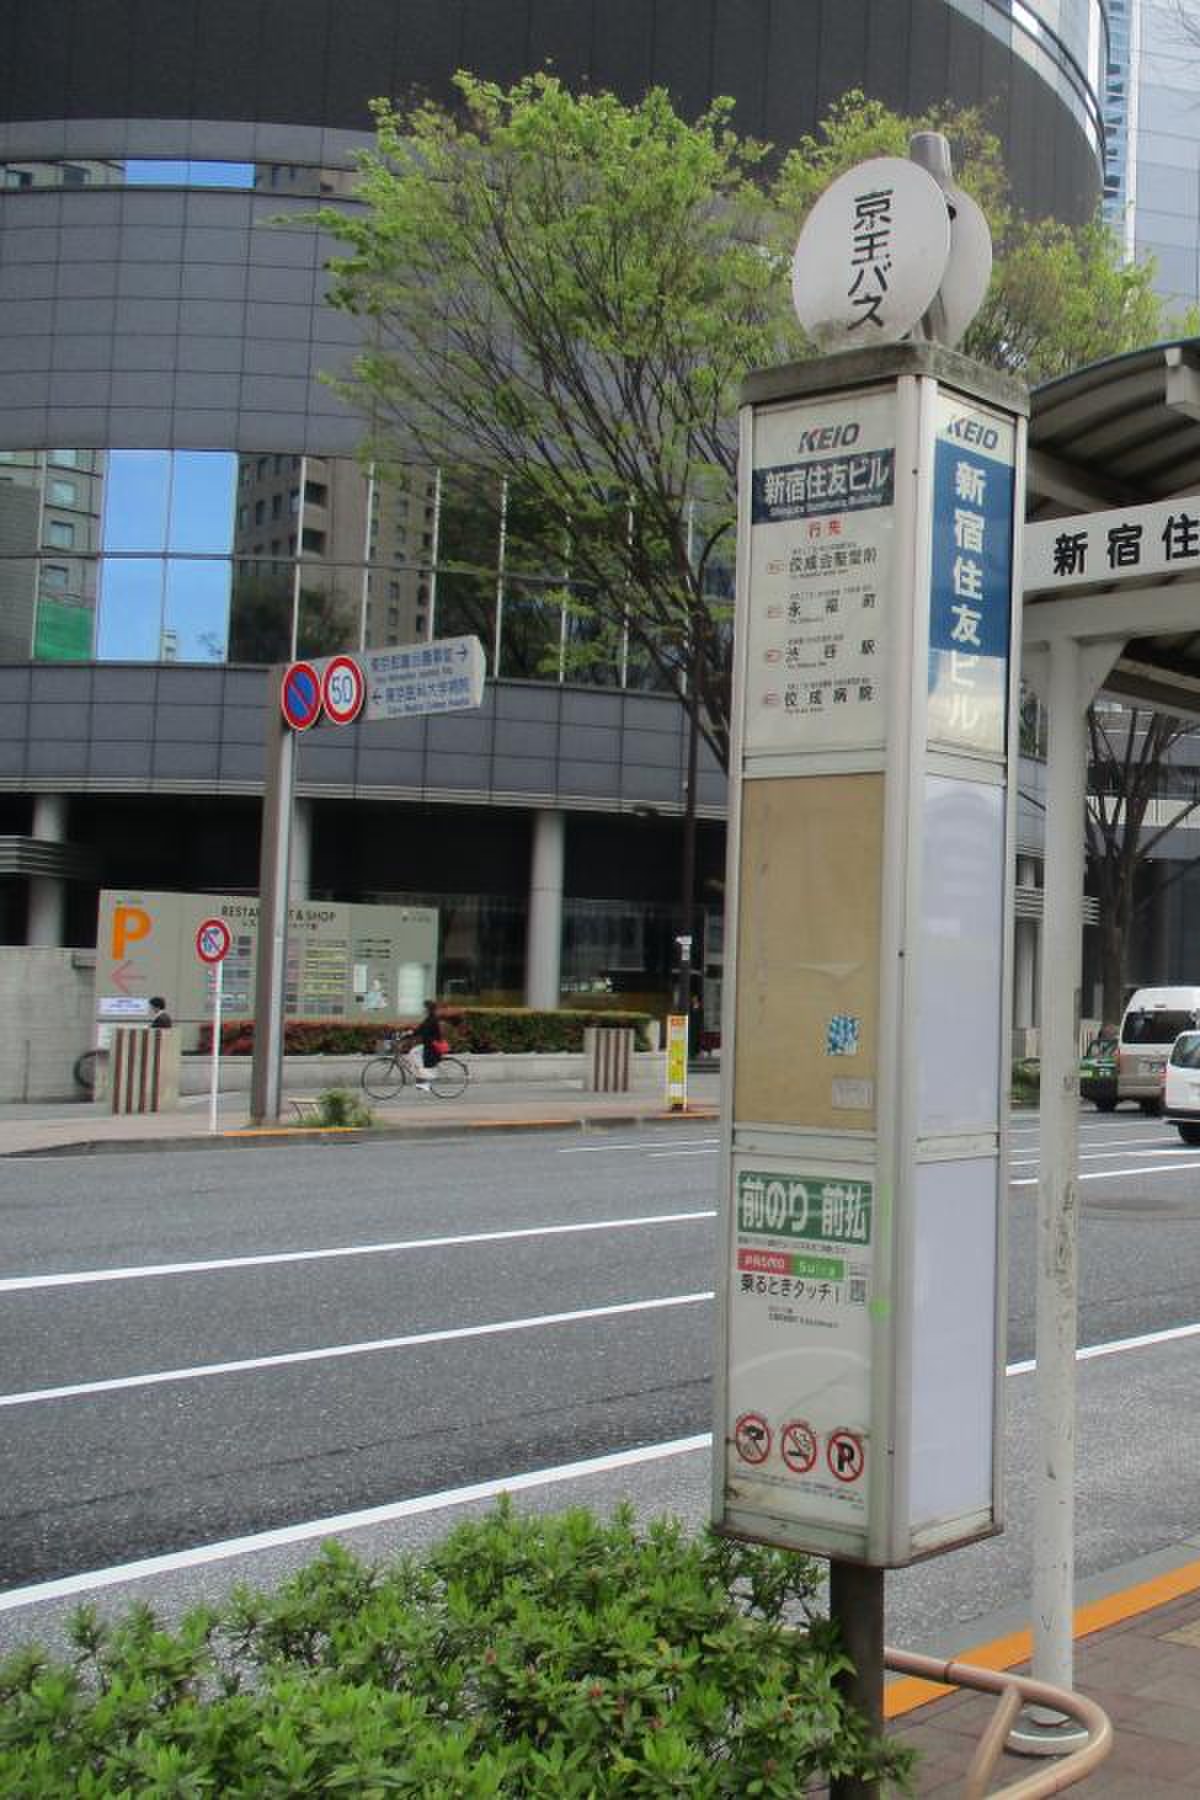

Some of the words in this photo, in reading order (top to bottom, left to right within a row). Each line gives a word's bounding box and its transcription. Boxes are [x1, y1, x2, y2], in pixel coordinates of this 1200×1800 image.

[848, 189, 893, 331] 京王バス
[798, 423, 860, 454] KEIO
[947, 417, 998, 450] KEIO
[765, 457, 889, 506] 新宿住友ビル
[950, 461, 986, 730] 新宿住友ビル
[331, 676, 353, 705] 50
[112, 907, 152, 960] P
[221, 905, 293, 922] RESTAT
[306, 911, 336, 922] SHOP
[742, 1177, 808, 1232] 前のり
[822, 1184, 867, 1239] 前払
